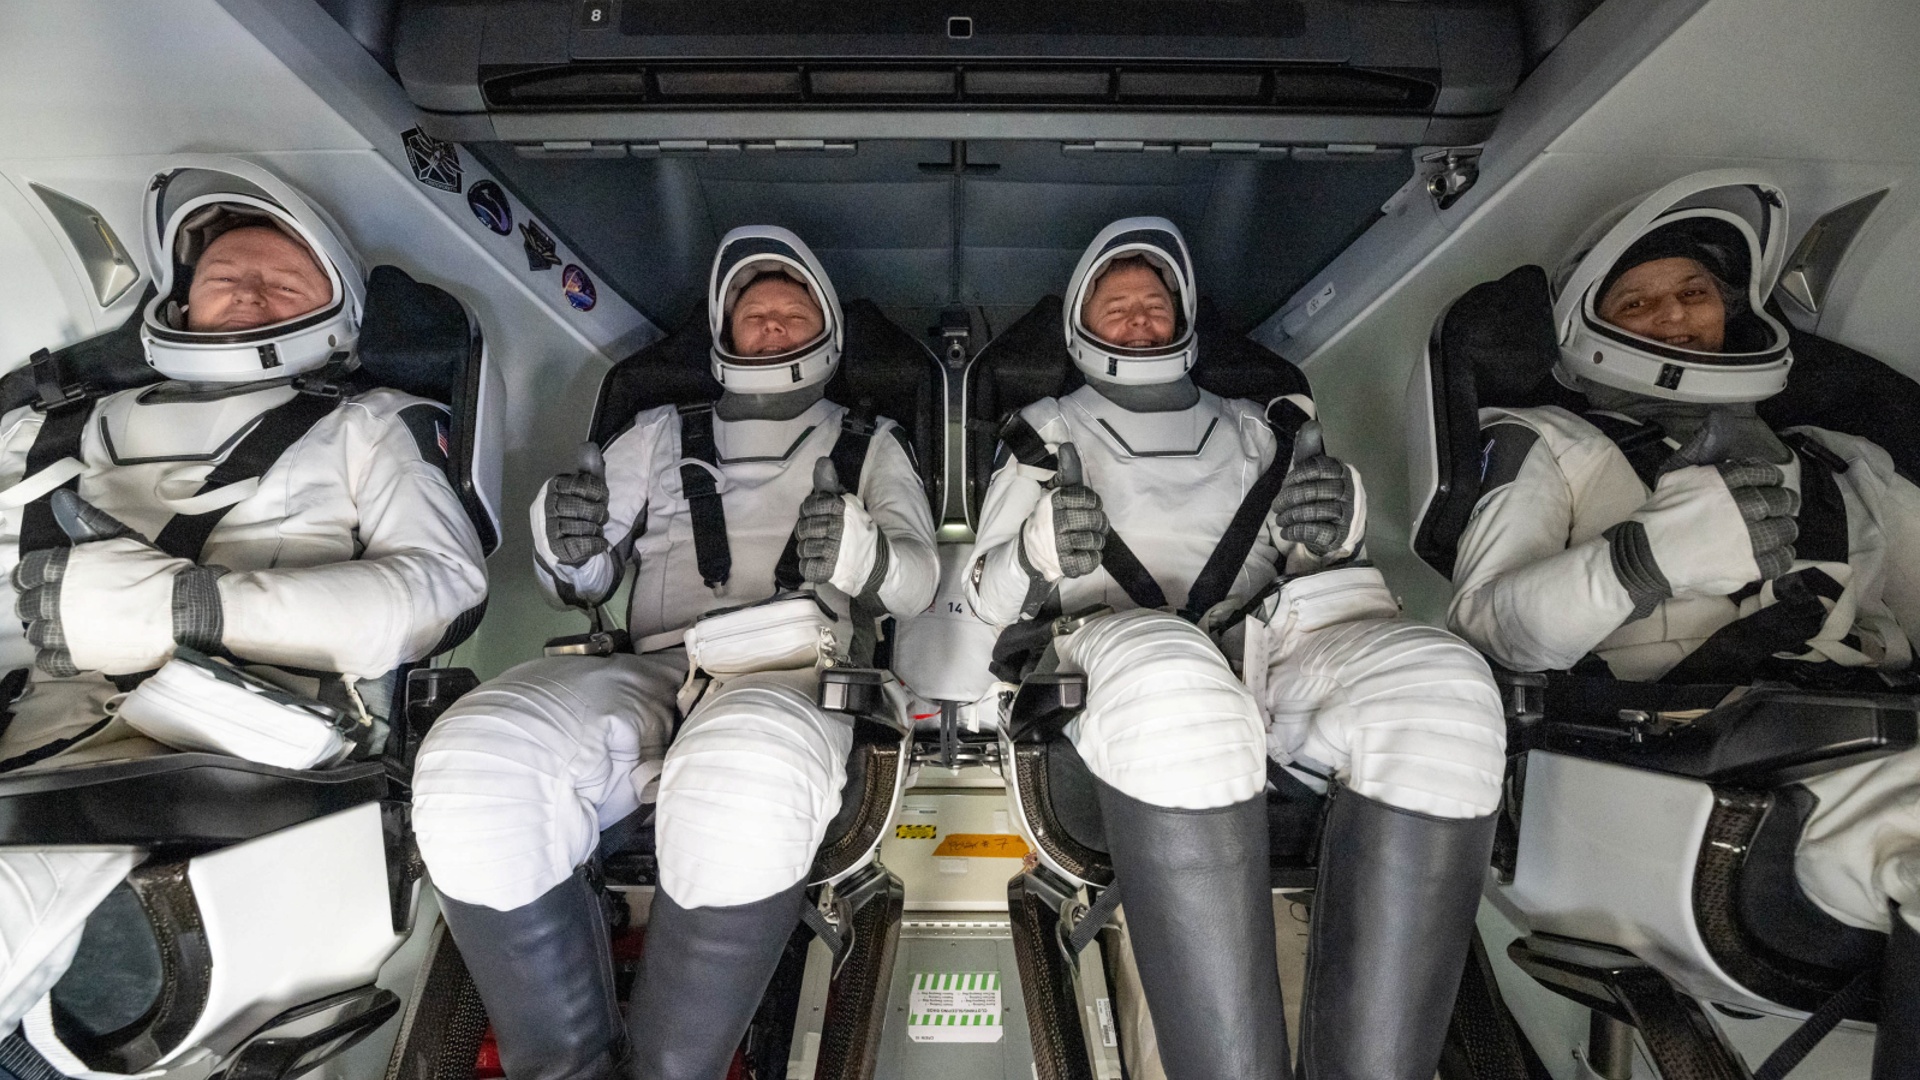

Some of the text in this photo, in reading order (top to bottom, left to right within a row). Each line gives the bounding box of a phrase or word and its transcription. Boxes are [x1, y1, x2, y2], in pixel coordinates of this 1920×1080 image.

[591, 9, 602, 21] 8
[947, 602, 963, 614] 14
[993, 837, 1009, 850] 7
